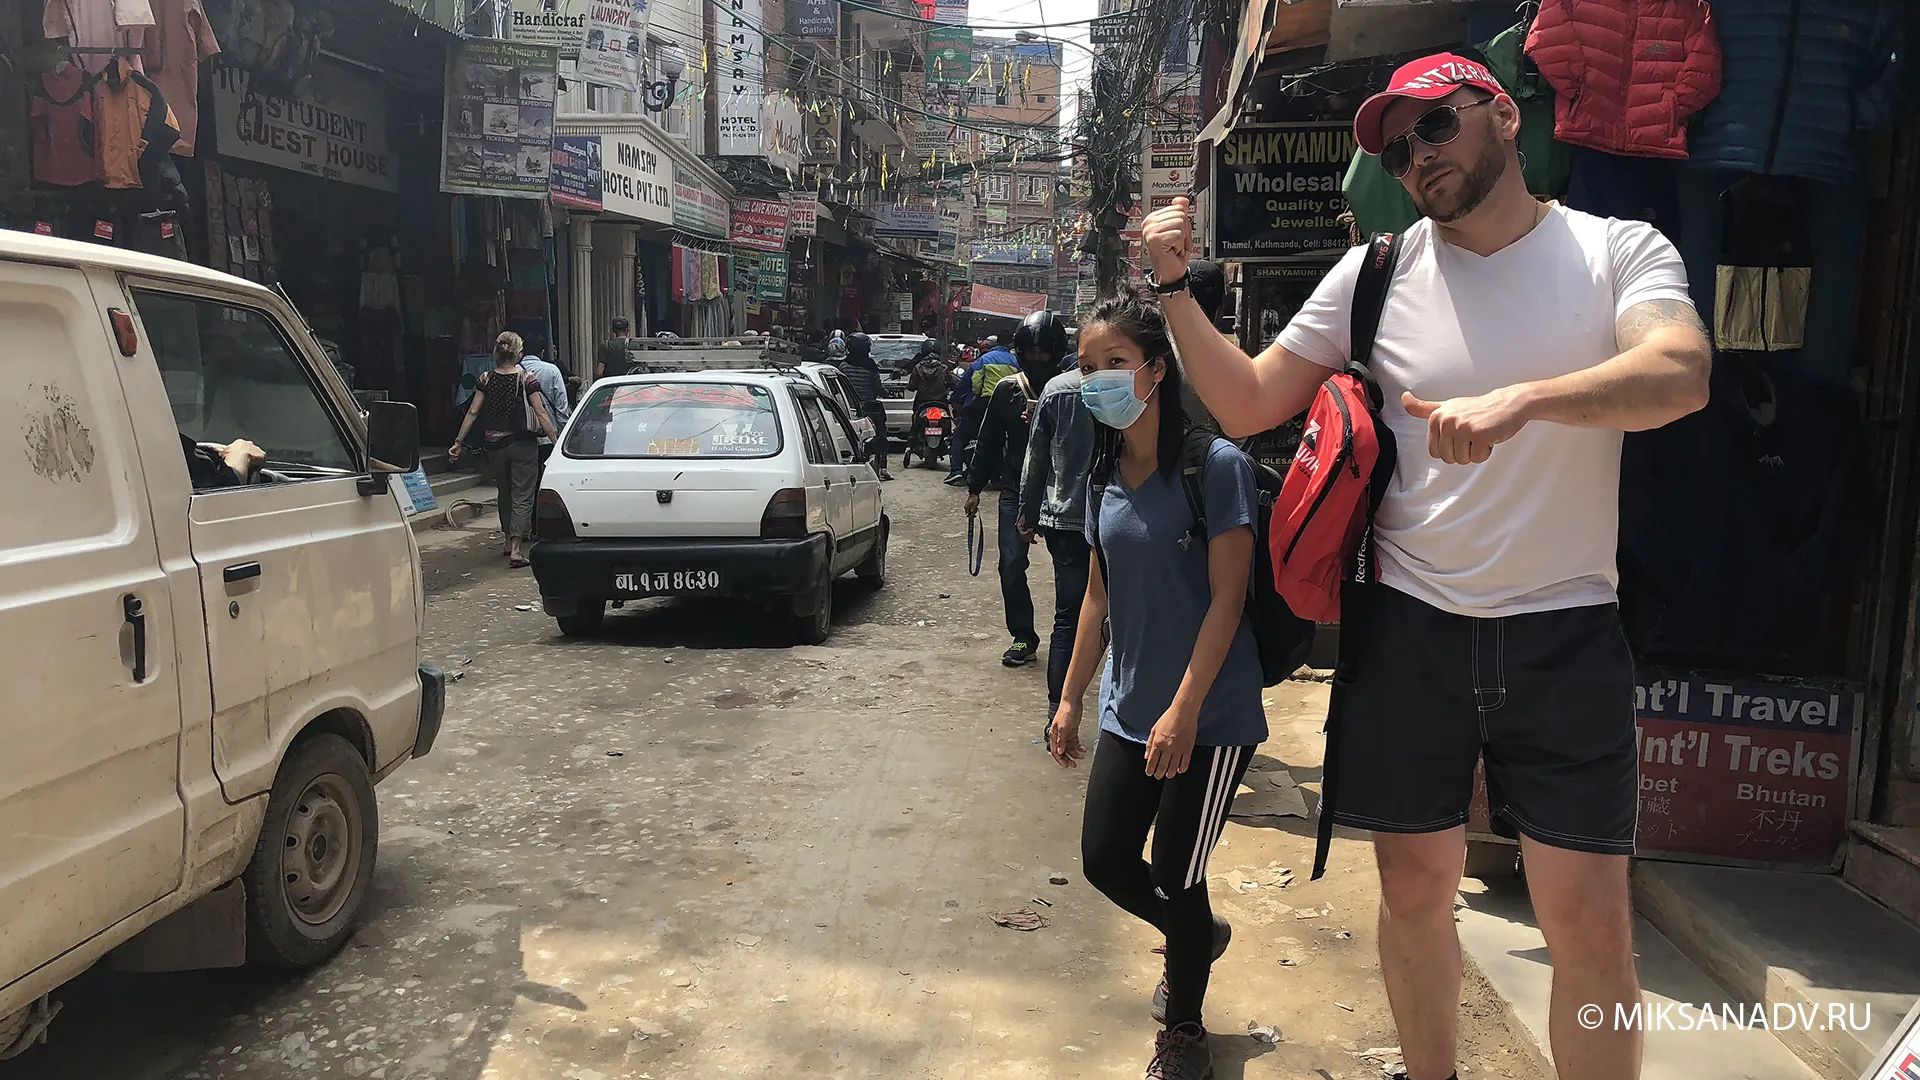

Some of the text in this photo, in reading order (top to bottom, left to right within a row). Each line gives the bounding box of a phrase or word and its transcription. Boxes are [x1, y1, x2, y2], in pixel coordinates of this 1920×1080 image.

[513, 11, 586, 27] Handicraf
[591, 5, 630, 26] LAUNDRY
[802, 26, 833, 35] Gallery
[266, 96, 367, 144] STUDENT
[236, 112, 389, 177] GUEST HOUSE
[1223, 132, 1354, 165] SHAKYAMUN
[618, 142, 656, 175] NAMSAY
[603, 170, 634, 199] HOTEL
[637, 180, 654, 204] PVT.
[655, 185, 671, 208] LTD.
[1233, 171, 1341, 193] Wholesal
[751, 202, 766, 214] CAVE
[765, 203, 790, 217] KITCHEN
[791, 211, 815, 222] HOTEL
[1264, 198, 1349, 213] Quality Ch
[1221, 240, 1251, 250] Thamel,
[1253, 239, 1299, 249] Kathmandu,
[1302, 239, 1319, 247] Cell:
[760, 257, 786, 273] HOTEL
[1636, 680, 1839, 727] nt'l Travel
[1724, 734, 1839, 780] Treks
[1736, 783, 1826, 808] Bhutan
[1749, 808, 1803, 832] 不丹
[1734, 832, 1808, 851] ブータン
